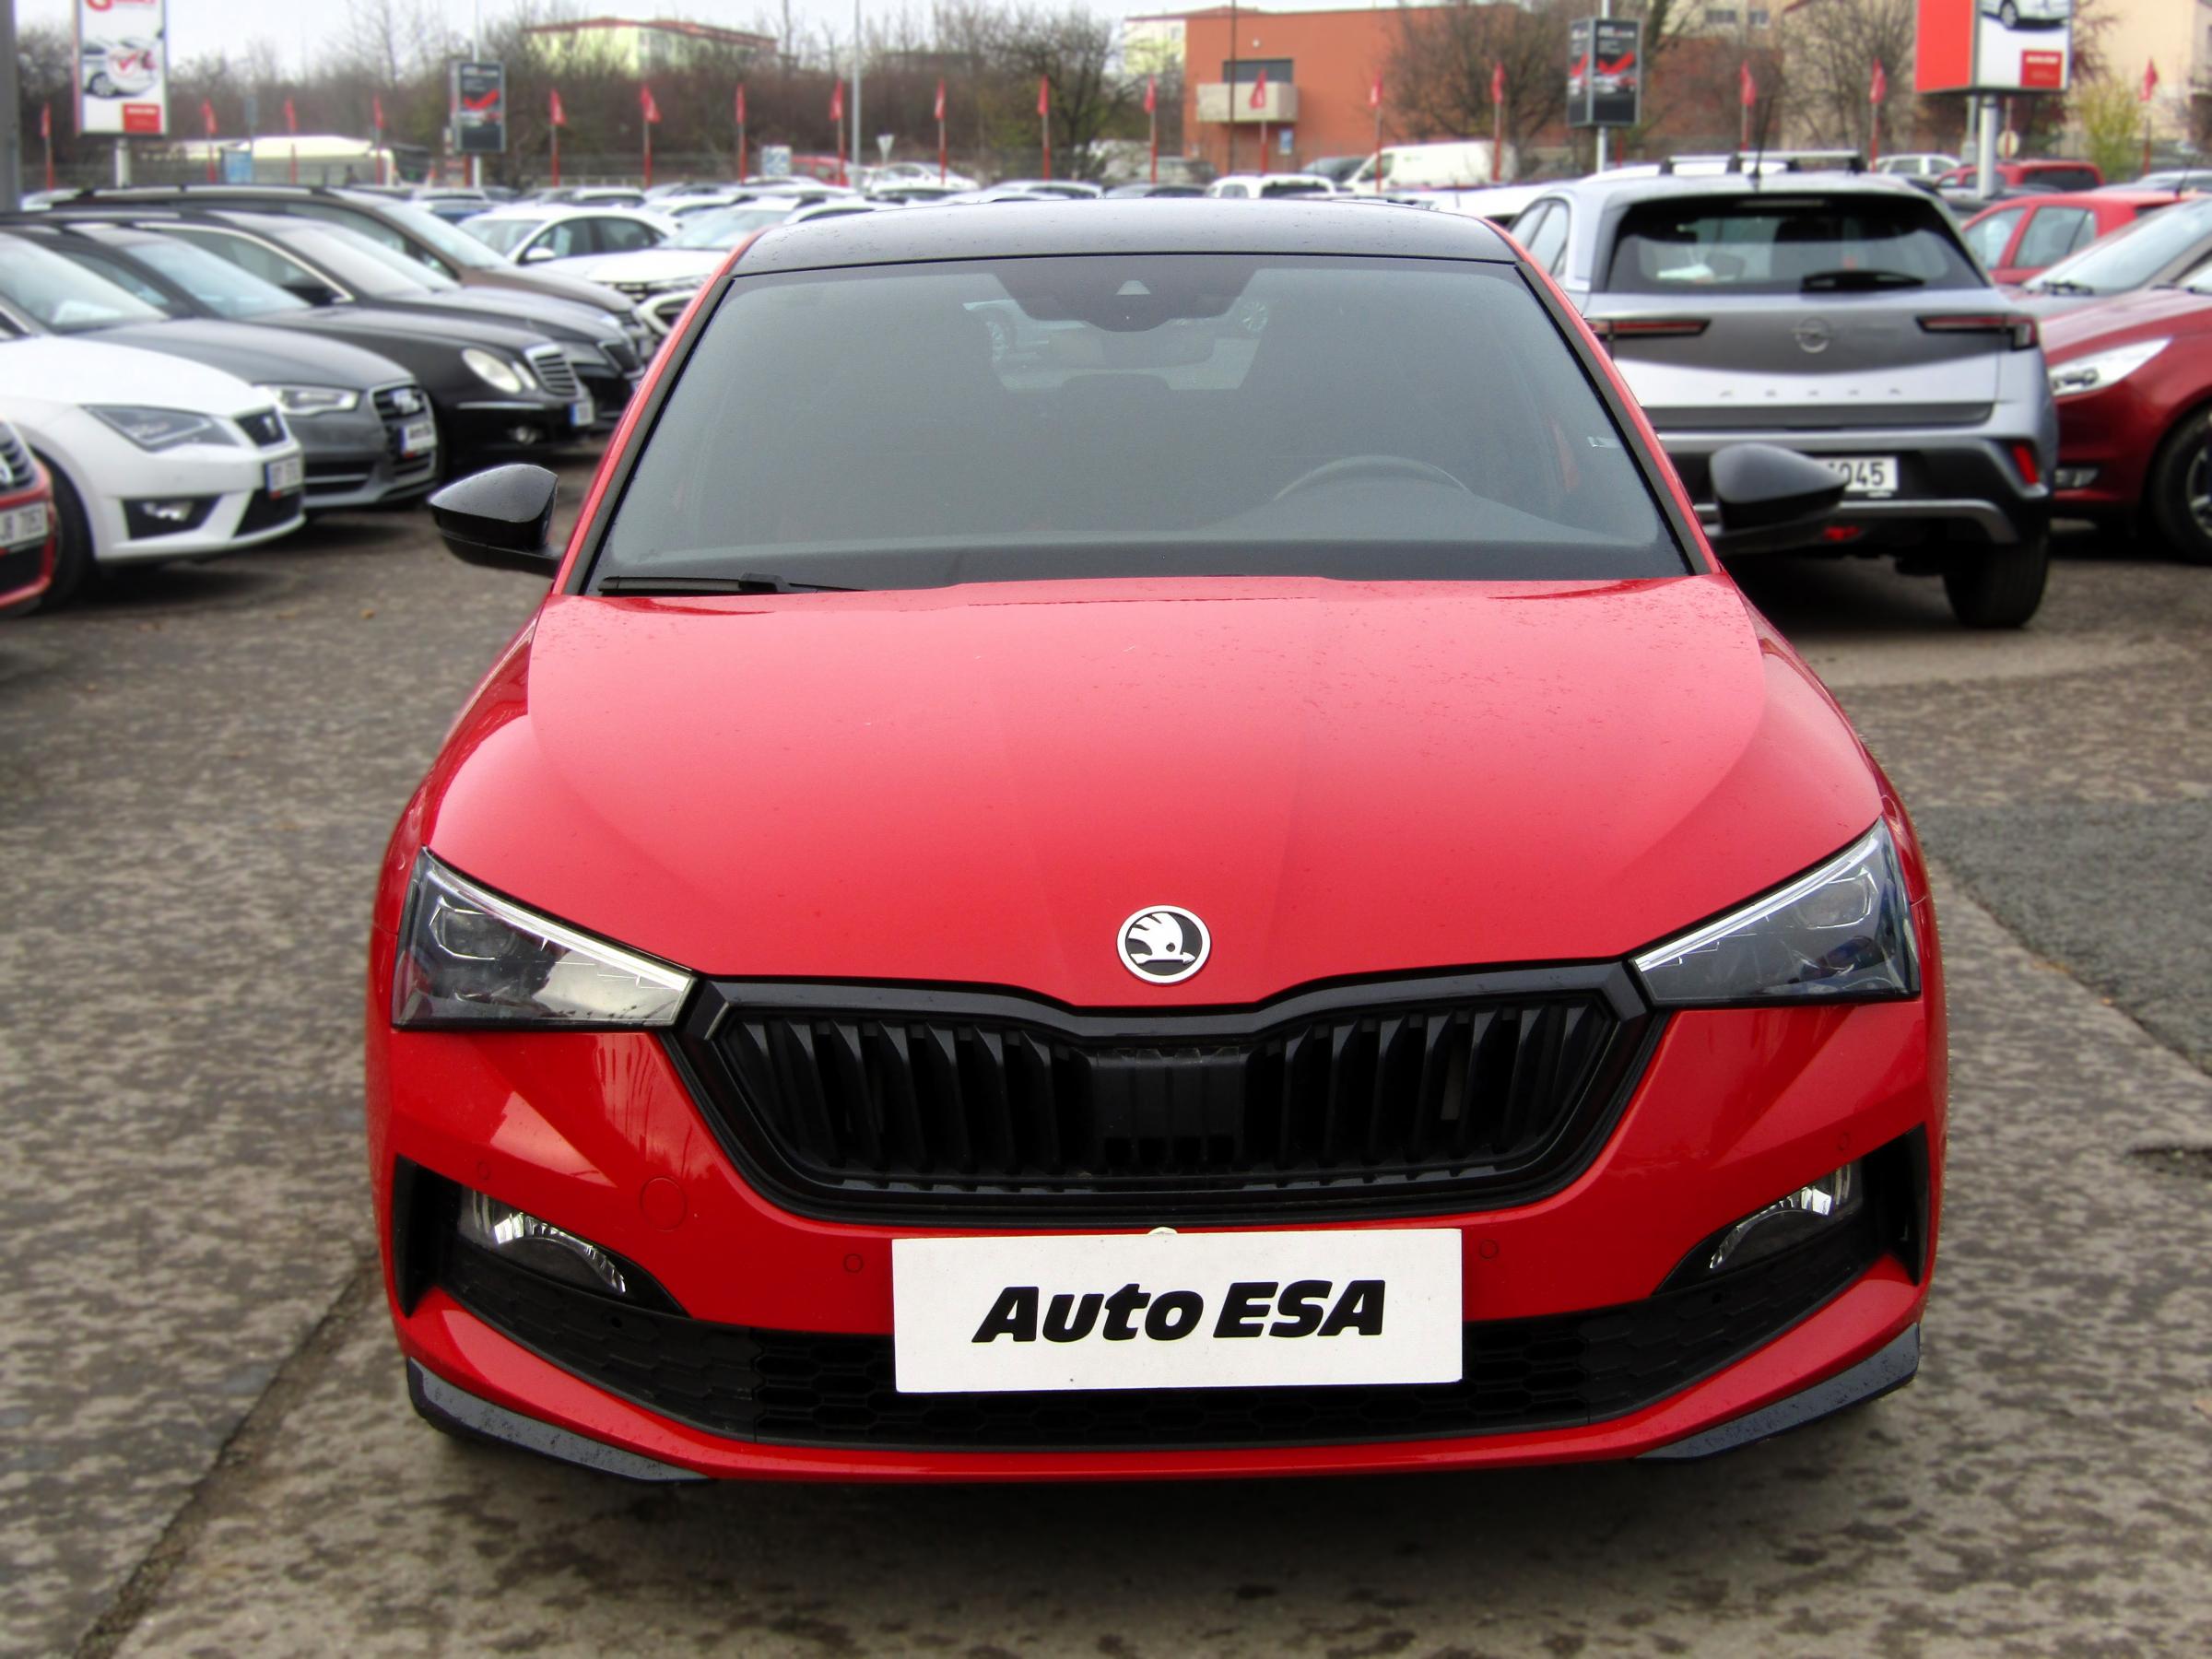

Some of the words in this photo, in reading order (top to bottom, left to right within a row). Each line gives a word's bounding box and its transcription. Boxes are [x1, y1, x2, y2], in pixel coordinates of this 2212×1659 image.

[1829, 462, 1885, 487] 045
[971, 1283, 1204, 1344] Auto
[1212, 1279, 1385, 1338] ESA
